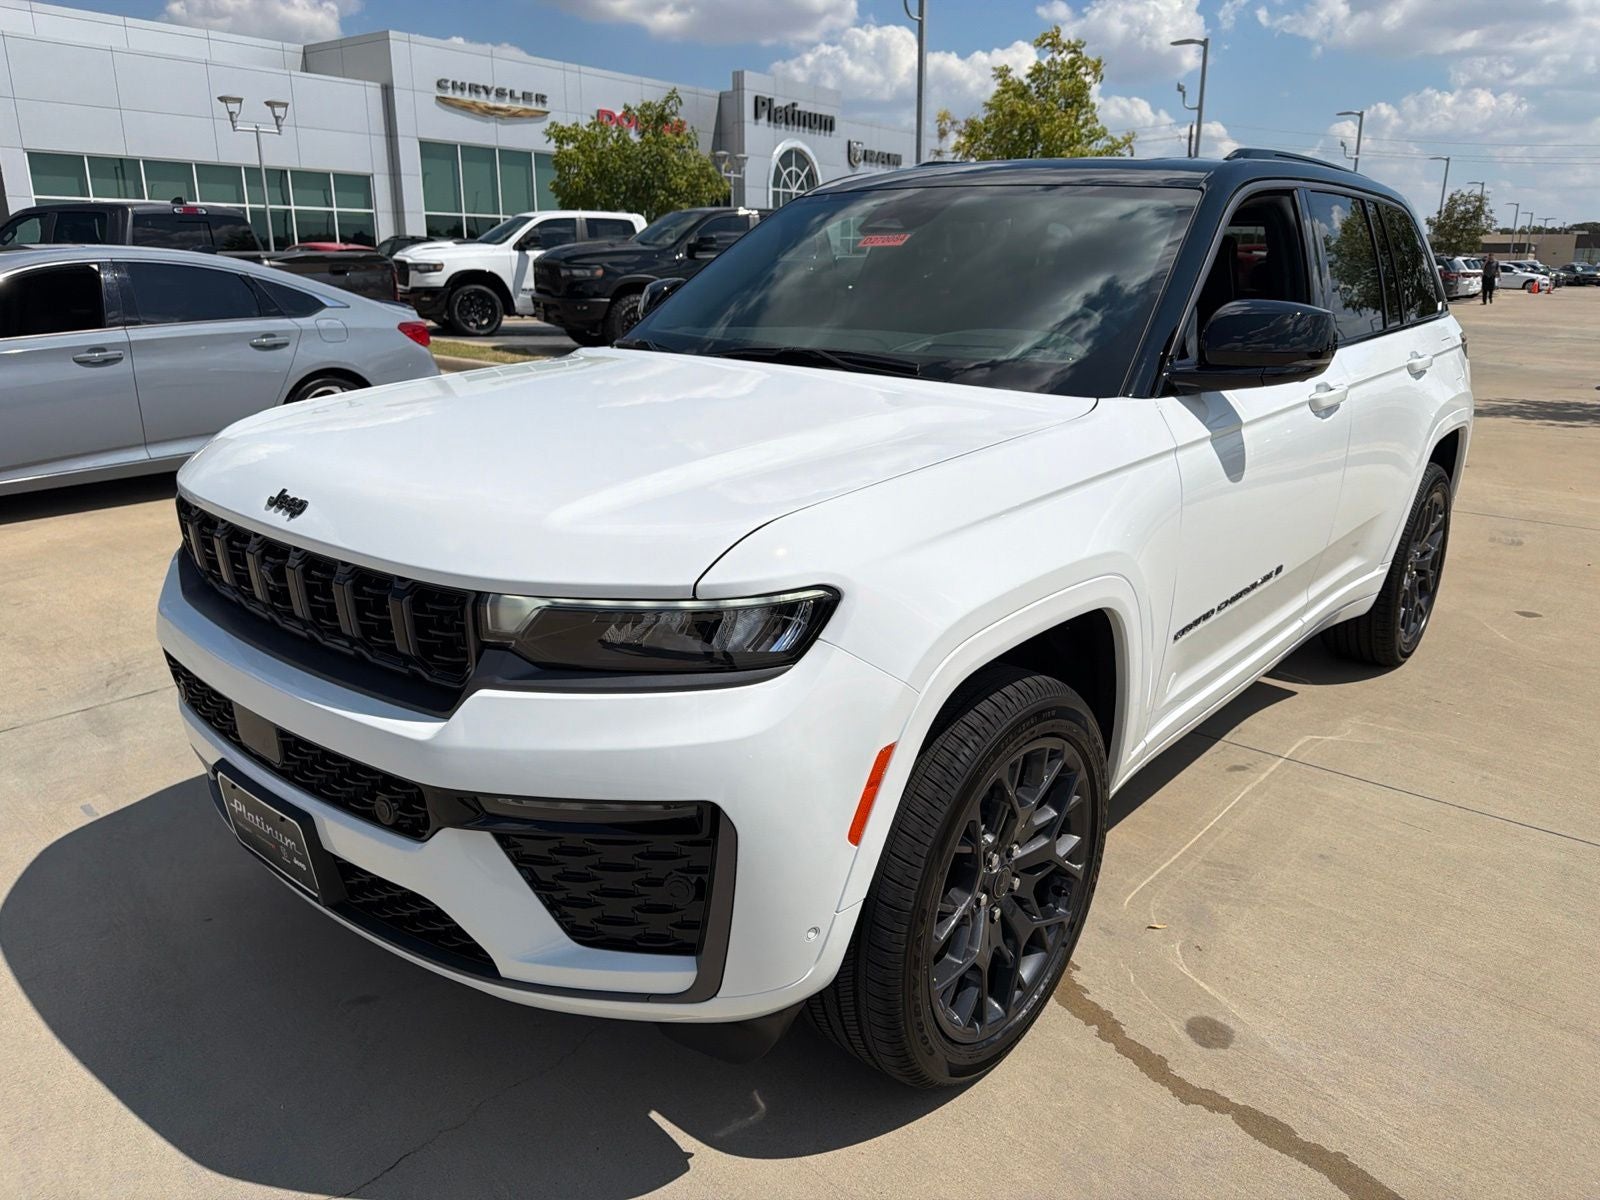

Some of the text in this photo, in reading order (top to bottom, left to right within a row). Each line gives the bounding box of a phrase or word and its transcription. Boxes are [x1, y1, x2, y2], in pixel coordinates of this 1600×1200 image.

[436, 78, 548, 104] CHRYSLER
[754, 95, 835, 132] Platinum
[864, 149, 902, 166] RAM
[267, 488, 309, 519] Jeep
[1173, 608, 1215, 641] GRAND
[230, 798, 302, 855] Platinum
